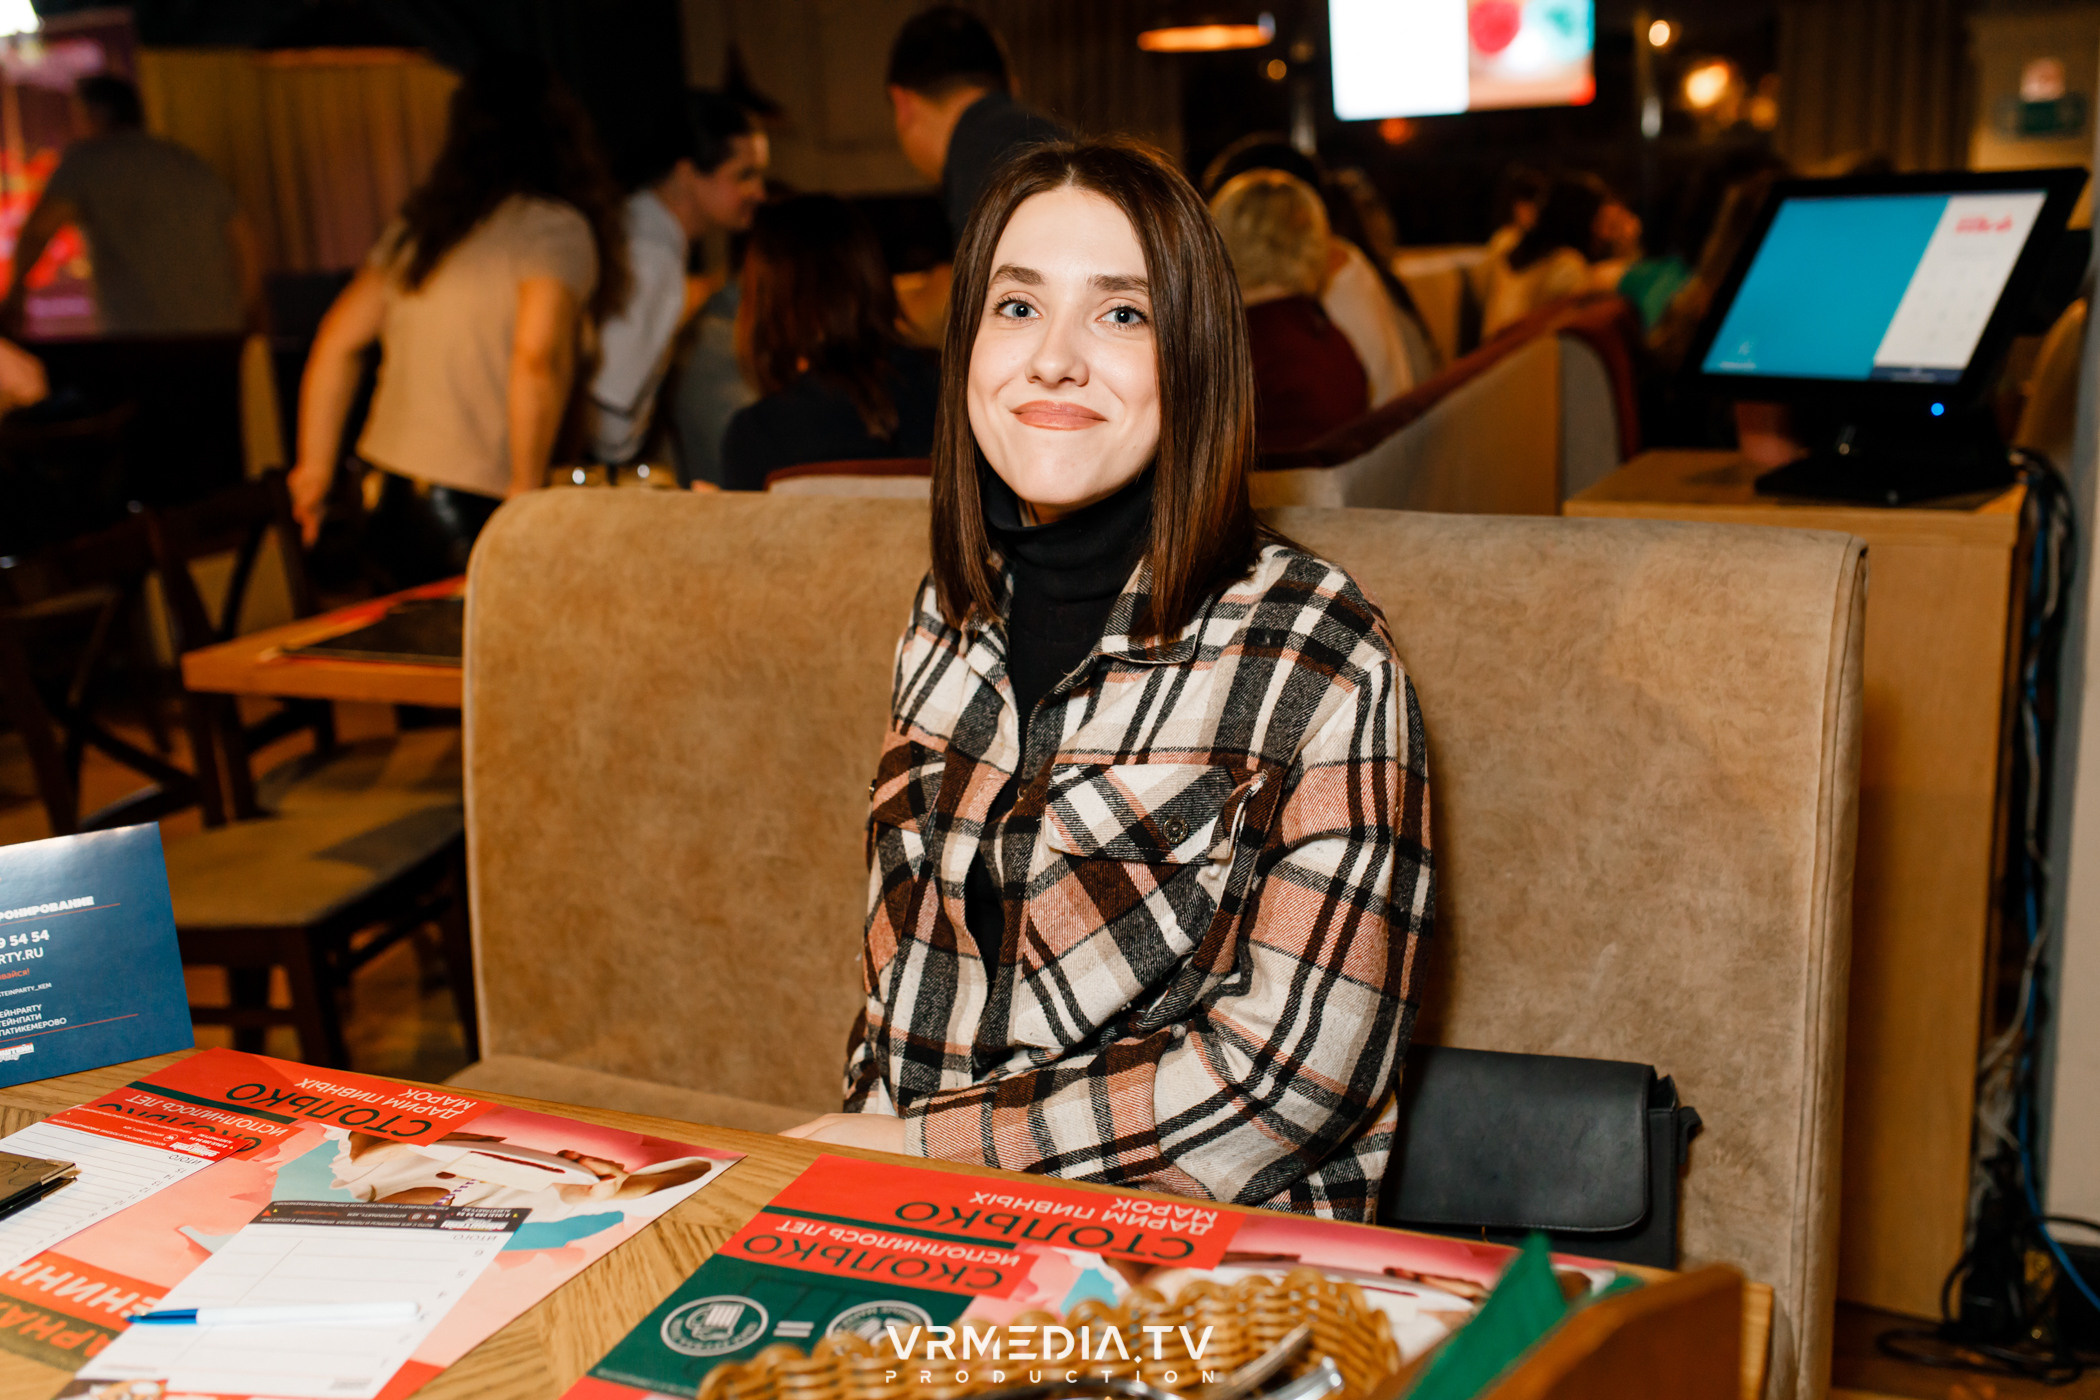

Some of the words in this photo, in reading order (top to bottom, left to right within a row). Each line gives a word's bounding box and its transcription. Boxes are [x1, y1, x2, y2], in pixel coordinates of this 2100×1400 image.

[9, 933, 29, 947] 54
[31, 929, 50, 943] 54
[125, 1094, 164, 1108] ЛЕТ
[293, 1078, 381, 1103] ПИВНЫХ
[398, 1088, 477, 1110] МАРОК
[161, 1102, 288, 1137] ИСПОЛНИЛОСЬ
[226, 1083, 432, 1137] СТОЛЬКО
[383, 1098, 464, 1120] ДАРИМ
[968, 1192, 1095, 1221] ПИВНЫХ
[1111, 1197, 1218, 1223] МАРОК
[775, 1220, 827, 1236] ЛЕТ
[895, 1202, 1195, 1260] СТОЛЬКО
[1101, 1210, 1214, 1236] ДАРИМ
[829, 1227, 1020, 1268] ИСПОЛНИЛОСЬ
[743, 1234, 1003, 1290] СКОЛЬКО
